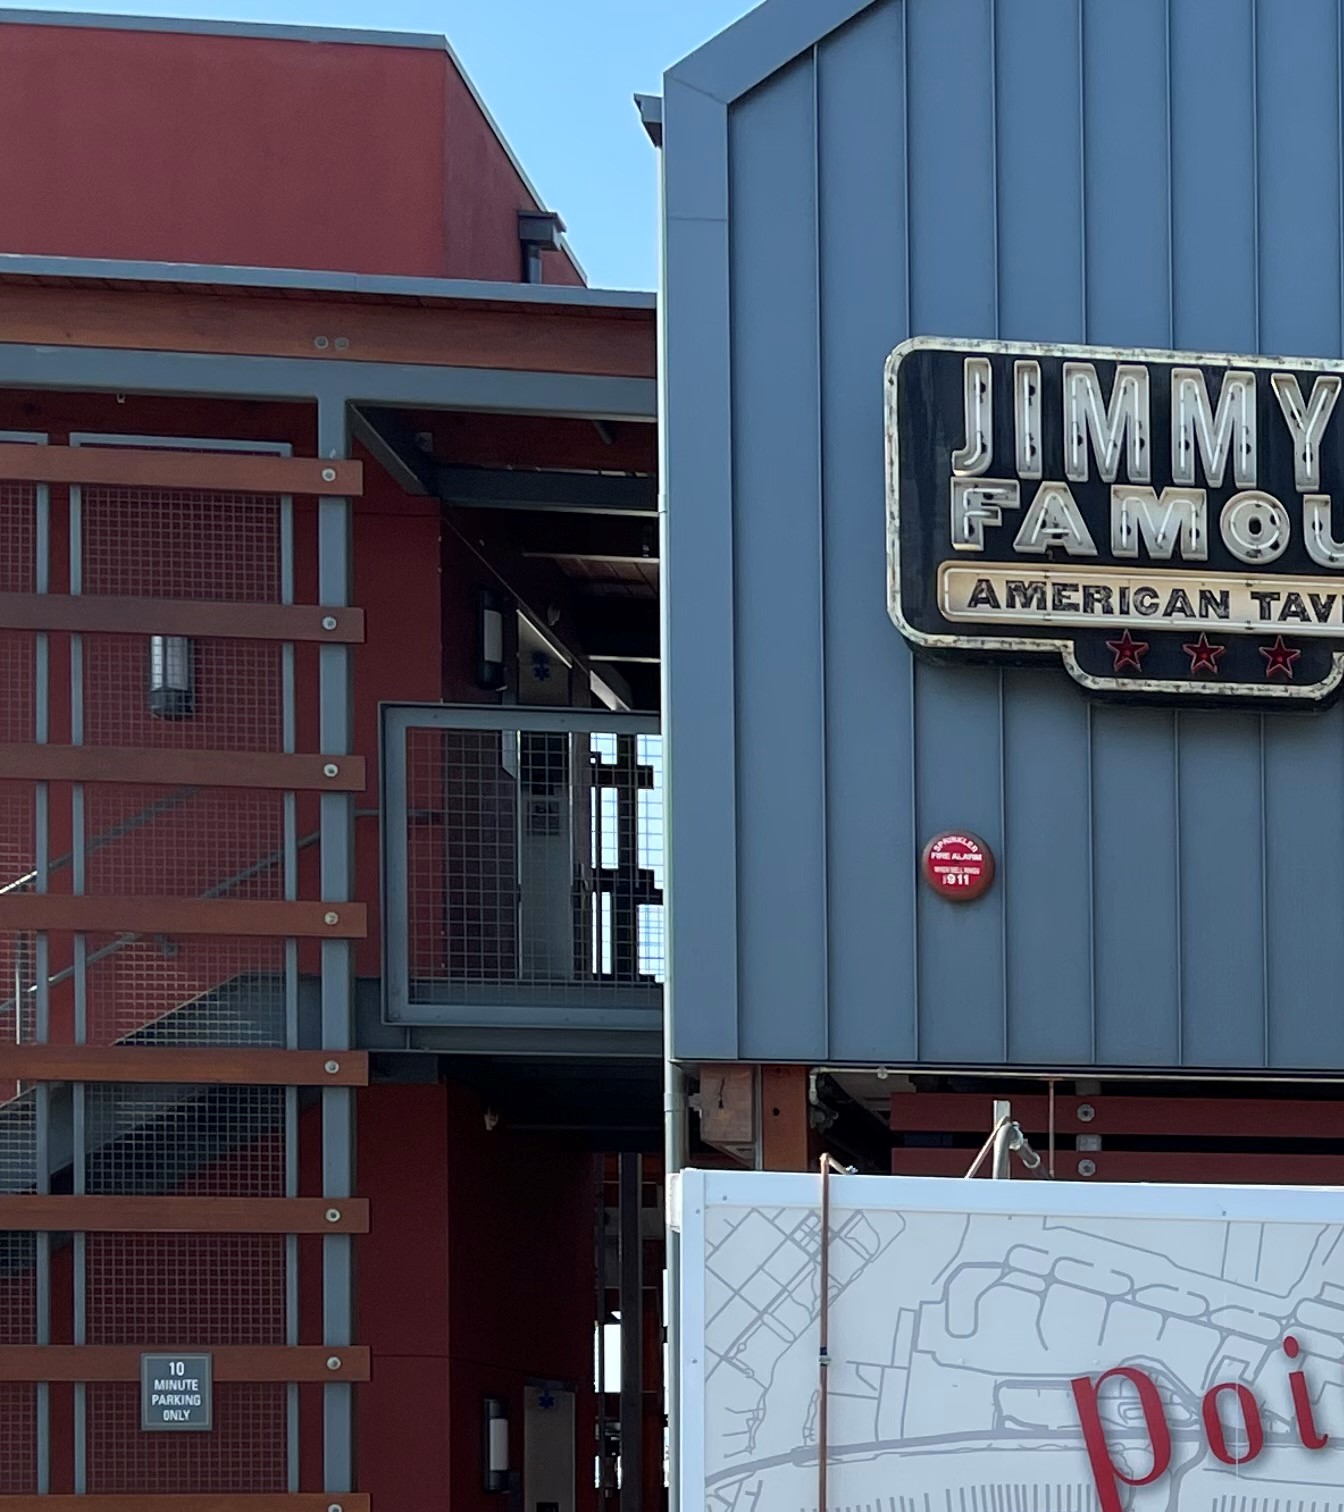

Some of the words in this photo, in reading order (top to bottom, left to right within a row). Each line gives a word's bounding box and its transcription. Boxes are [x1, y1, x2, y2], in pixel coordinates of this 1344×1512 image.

[967, 578, 1230, 620] AMERICAN
[169, 1361, 185, 1376] 10
[154, 1379, 199, 1391] MINUTE
[151, 1394, 201, 1406] PARKING
[163, 1409, 191, 1421] ONLY
